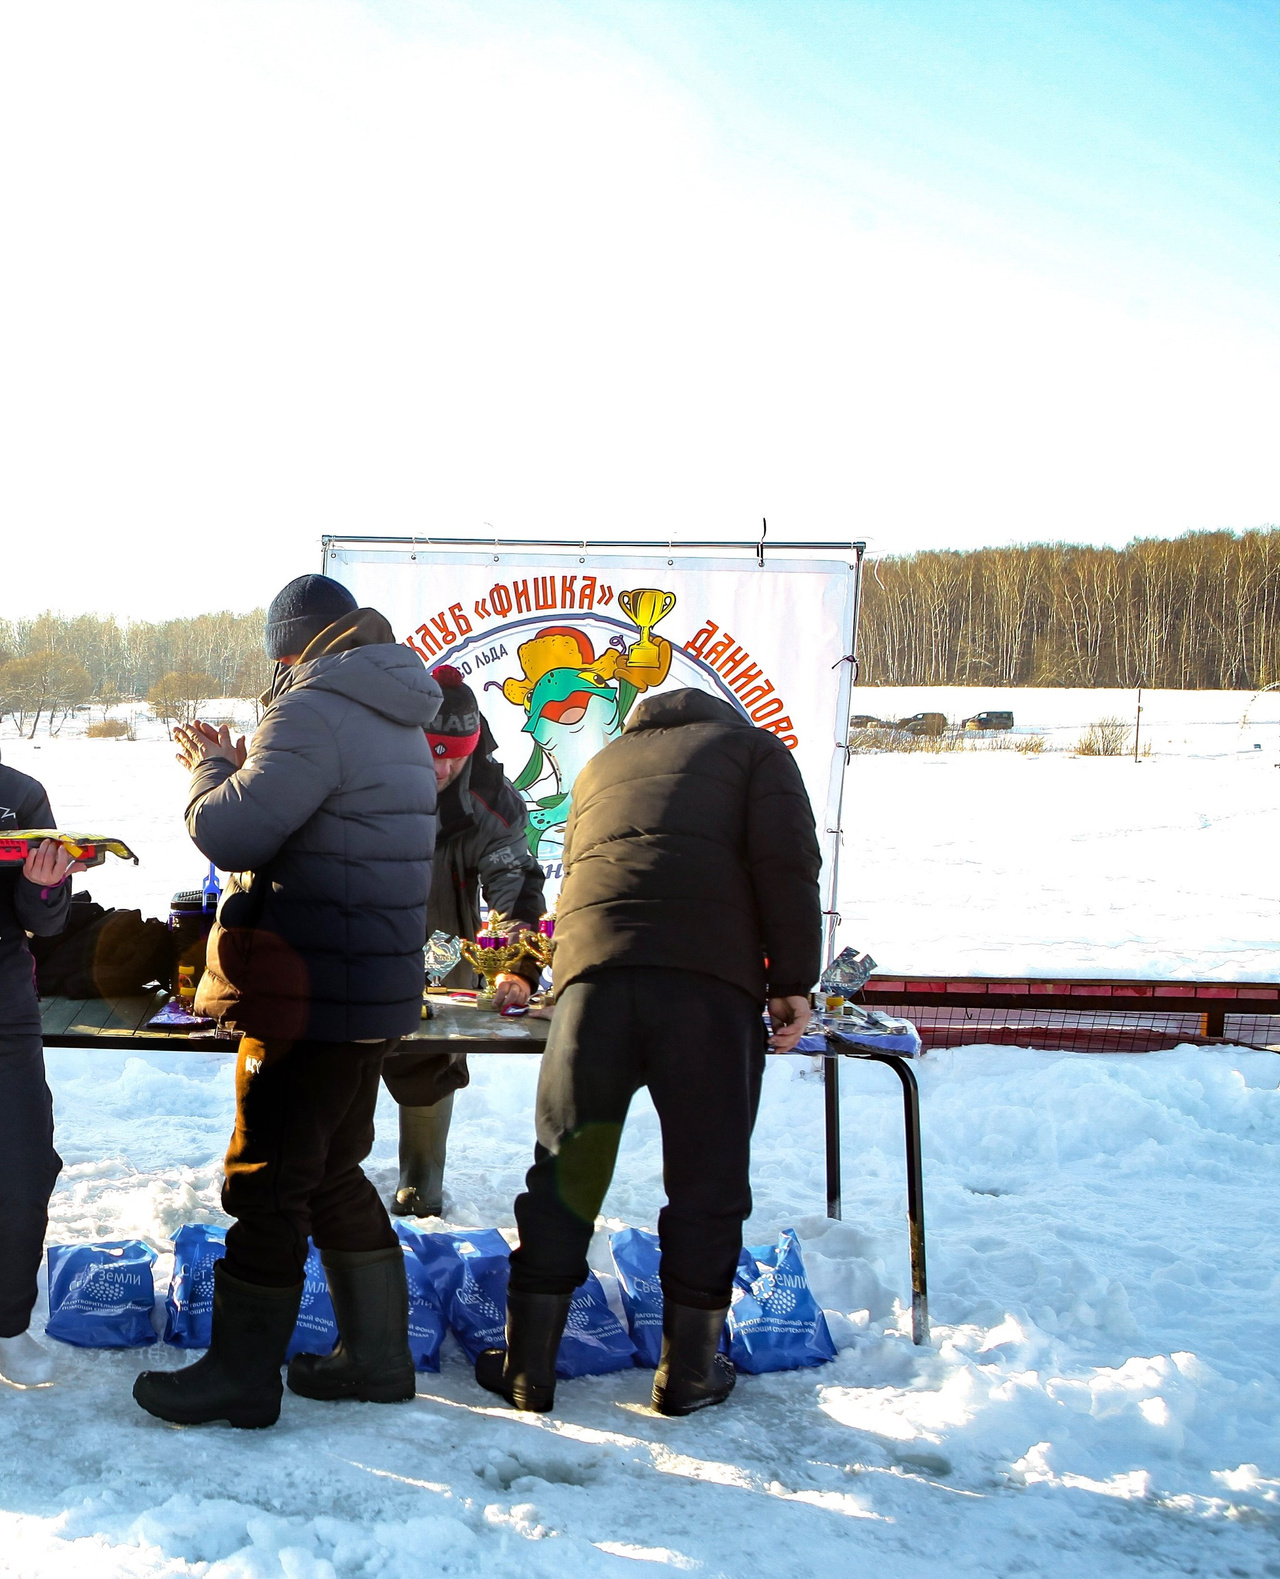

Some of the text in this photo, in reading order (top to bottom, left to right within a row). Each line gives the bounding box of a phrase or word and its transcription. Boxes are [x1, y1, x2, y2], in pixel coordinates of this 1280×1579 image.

[474, 575, 615, 619] «ФИШКА»
[474, 643, 509, 669] ЛЬДА
[98, 1270, 141, 1286] Земли
[181, 1263, 207, 1282] Сет
[634, 1277, 662, 1294] Све
